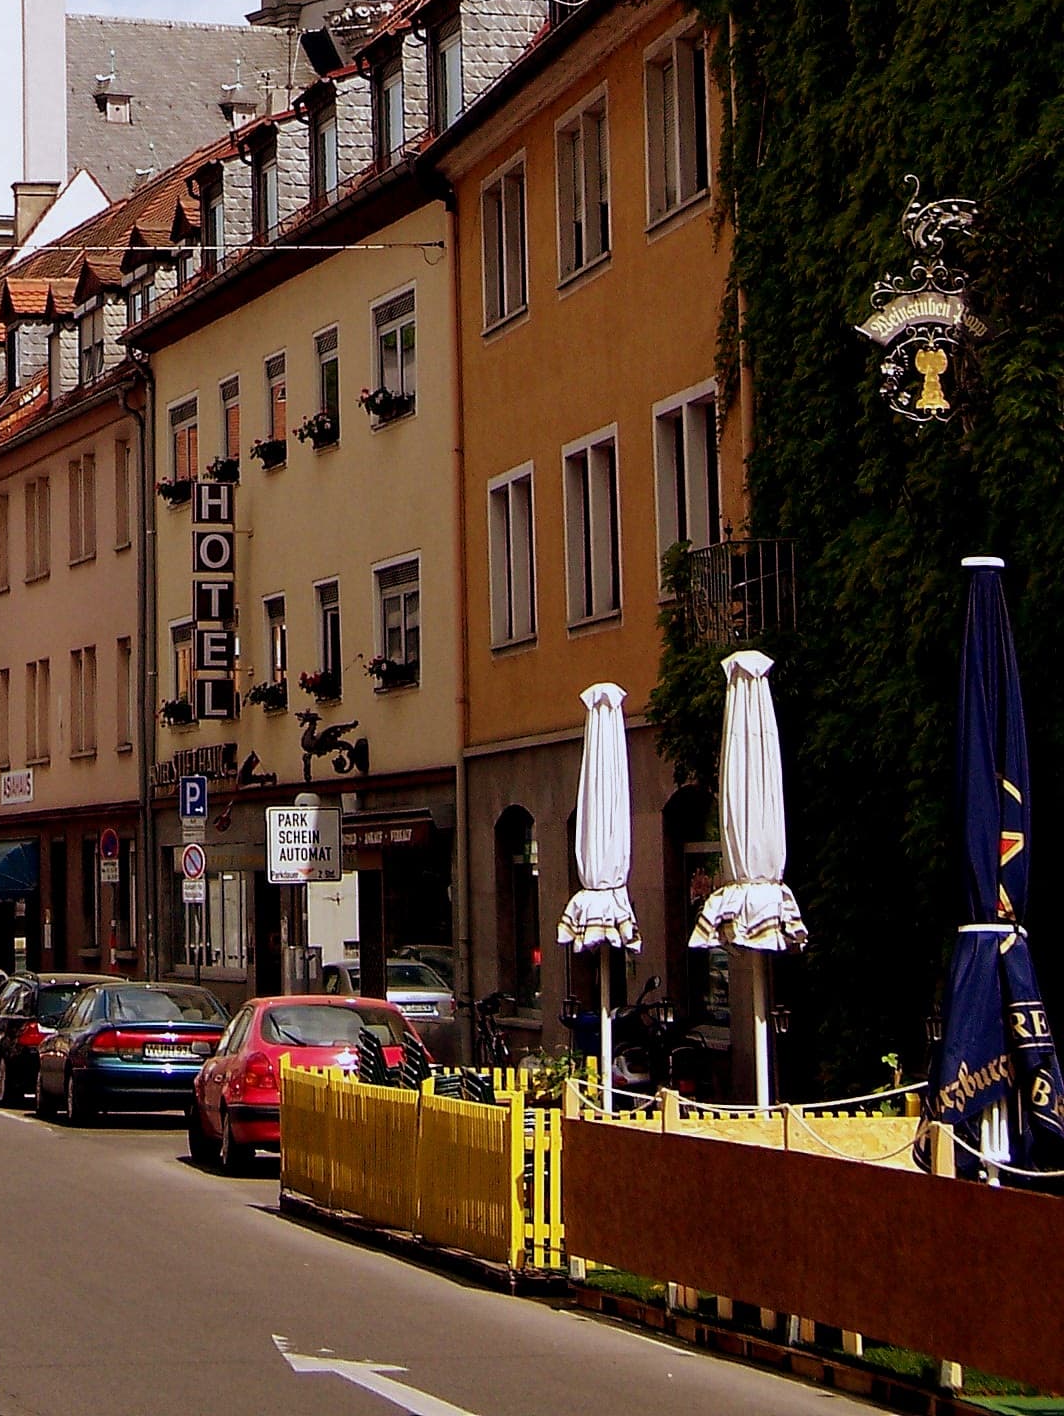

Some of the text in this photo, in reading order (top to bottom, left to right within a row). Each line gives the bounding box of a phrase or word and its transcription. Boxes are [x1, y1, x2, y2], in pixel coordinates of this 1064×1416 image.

[870, 301, 951, 338] Weinstuben
[200, 486, 231, 717] HOTEL
[186, 782, 201, 815] P
[278, 813, 308, 827] PARK
[278, 830, 320, 845] SCHEIN
[279, 847, 332, 862] AUTOMAT
